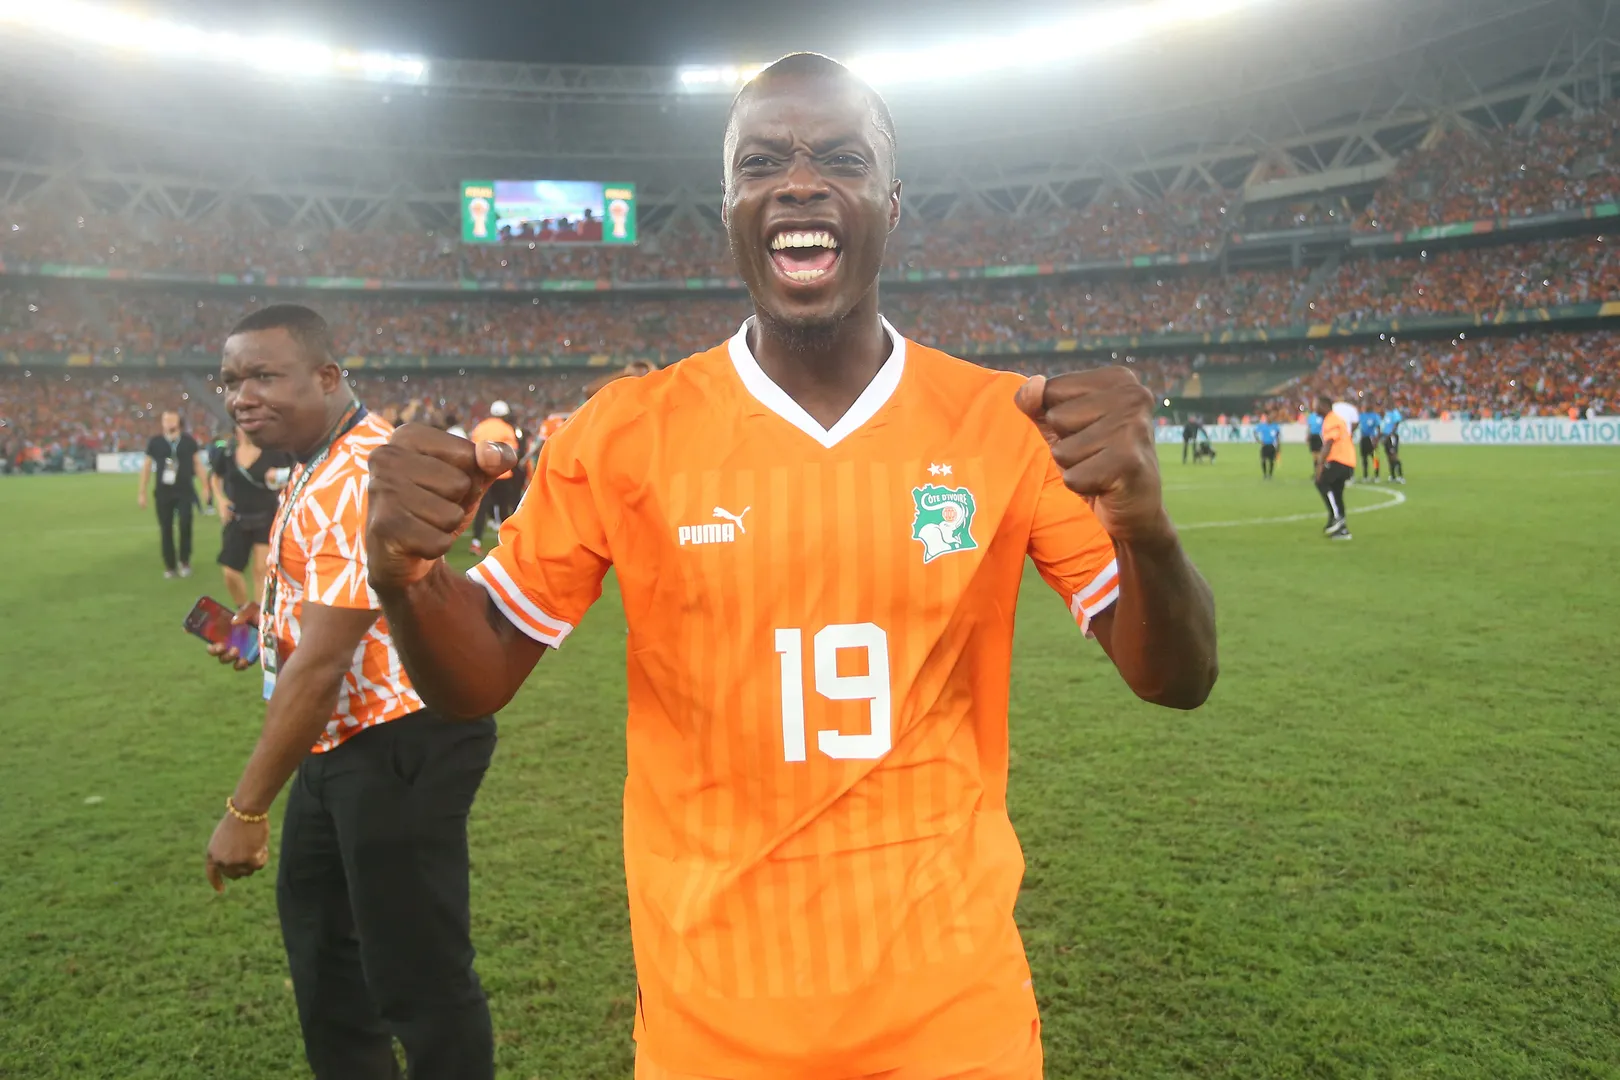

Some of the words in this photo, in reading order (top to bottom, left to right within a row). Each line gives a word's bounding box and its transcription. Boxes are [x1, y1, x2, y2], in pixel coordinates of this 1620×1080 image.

[1460, 421, 1620, 442] CONGRATULATIO
[678, 523, 734, 546] PUMA
[775, 622, 892, 762] 19
